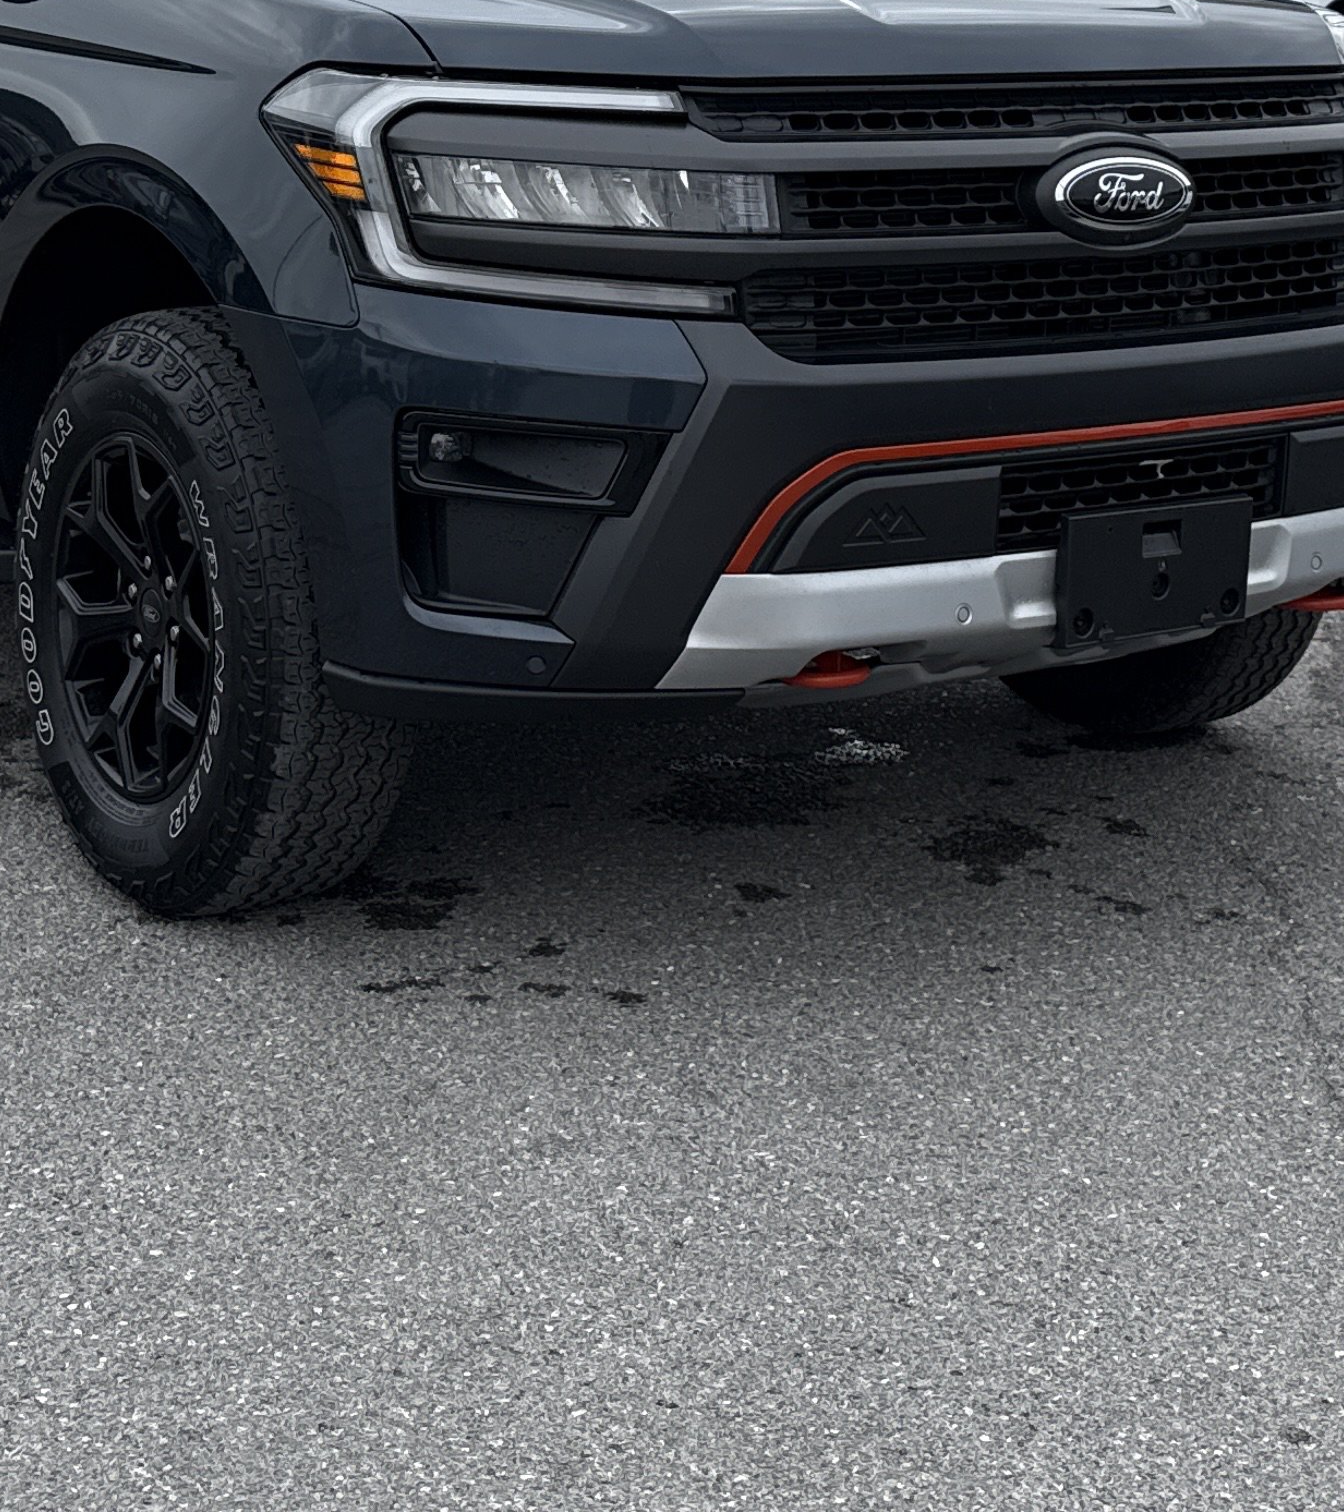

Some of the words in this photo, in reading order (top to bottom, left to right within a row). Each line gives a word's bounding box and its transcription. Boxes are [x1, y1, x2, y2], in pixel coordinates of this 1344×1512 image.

[1093, 173, 1165, 214] Ford
[17, 408, 74, 746] GOODYEAR
[168, 480, 225, 838] WRANGLER
